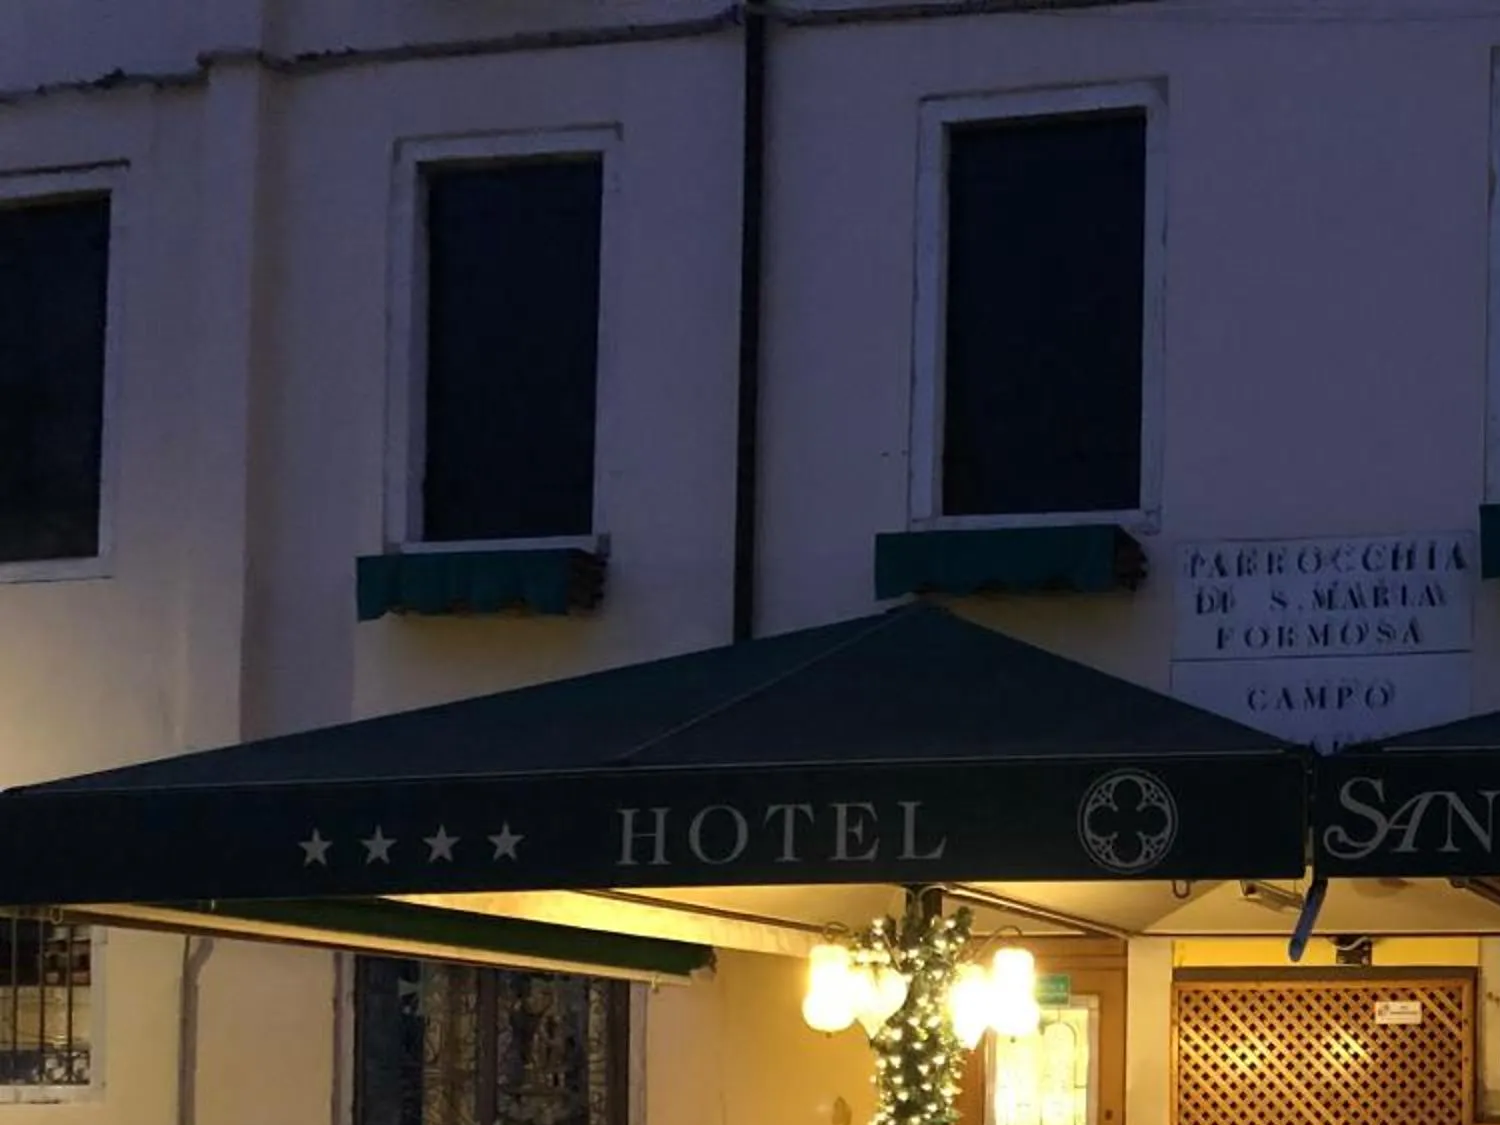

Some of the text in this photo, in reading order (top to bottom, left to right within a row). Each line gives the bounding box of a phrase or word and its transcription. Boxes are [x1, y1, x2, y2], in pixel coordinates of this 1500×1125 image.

[1189, 541, 1467, 578] PARROCCHIA
[1196, 587, 1234, 614] DI
[1216, 617, 1421, 650] FORMOSA
[1247, 681, 1391, 711] CAMPO
[614, 799, 948, 867] HOTEL
